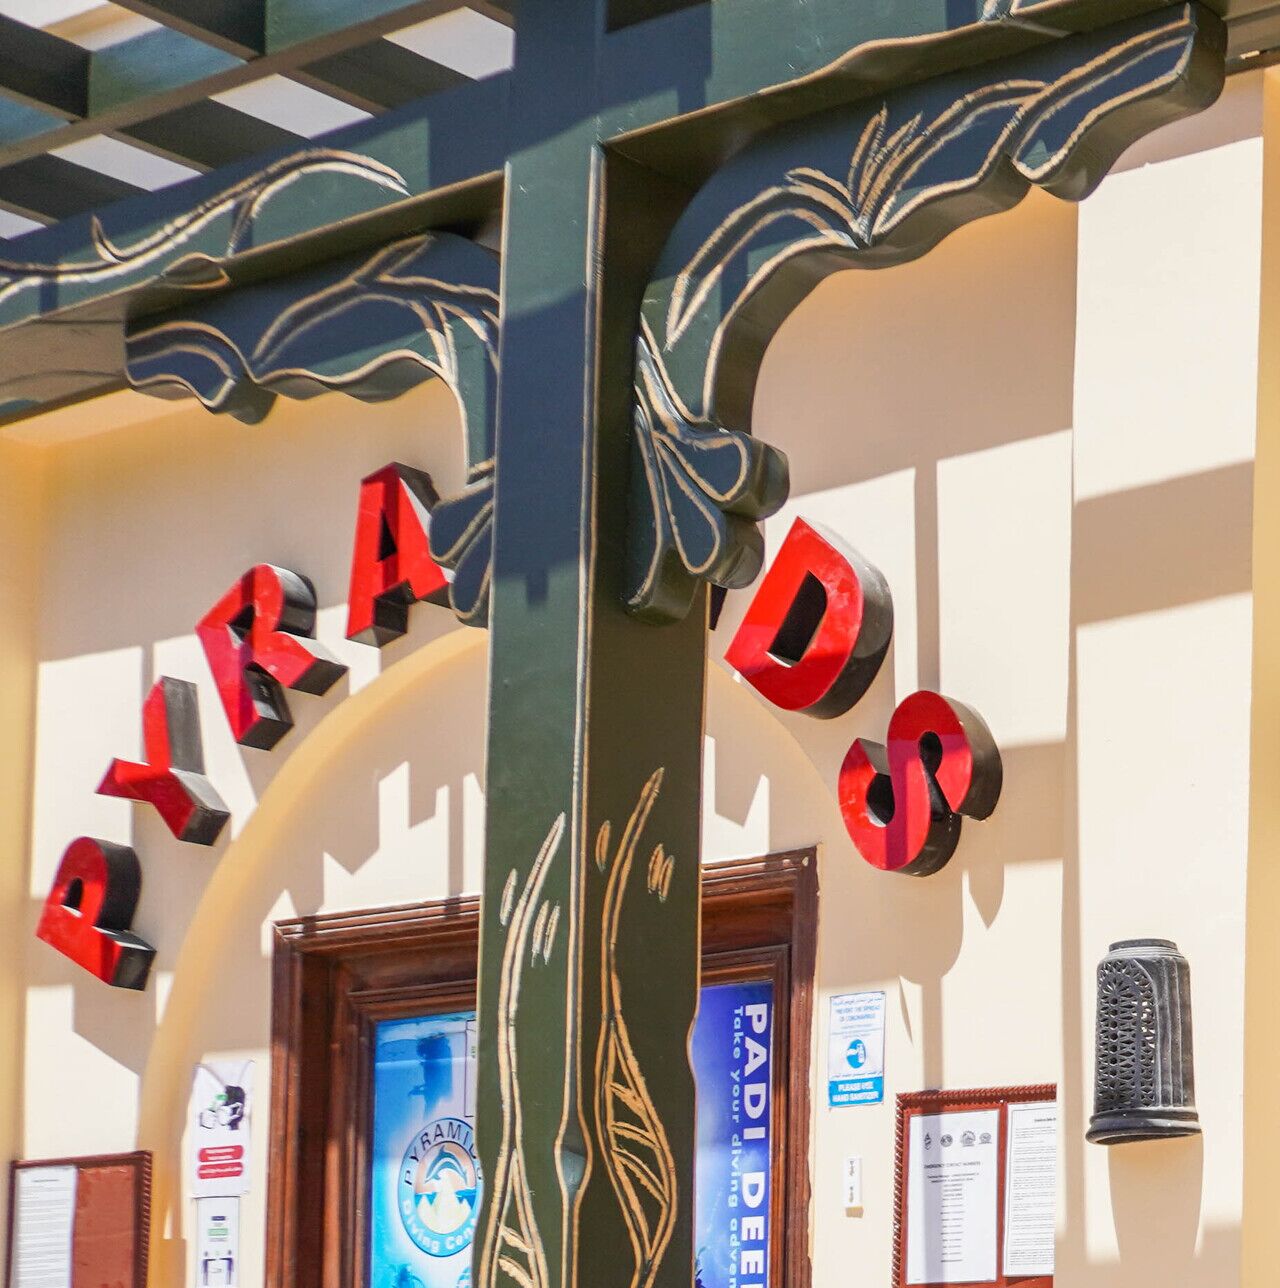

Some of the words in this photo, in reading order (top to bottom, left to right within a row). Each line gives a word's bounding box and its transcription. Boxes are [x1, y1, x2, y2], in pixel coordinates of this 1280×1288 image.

[36, 462, 1003, 991] PYRADS
[732, 1005, 744, 1059] Take
[730, 1069, 741, 1124] your
[743, 1003, 768, 1140] PADI
[728, 1133, 742, 1208] diving
